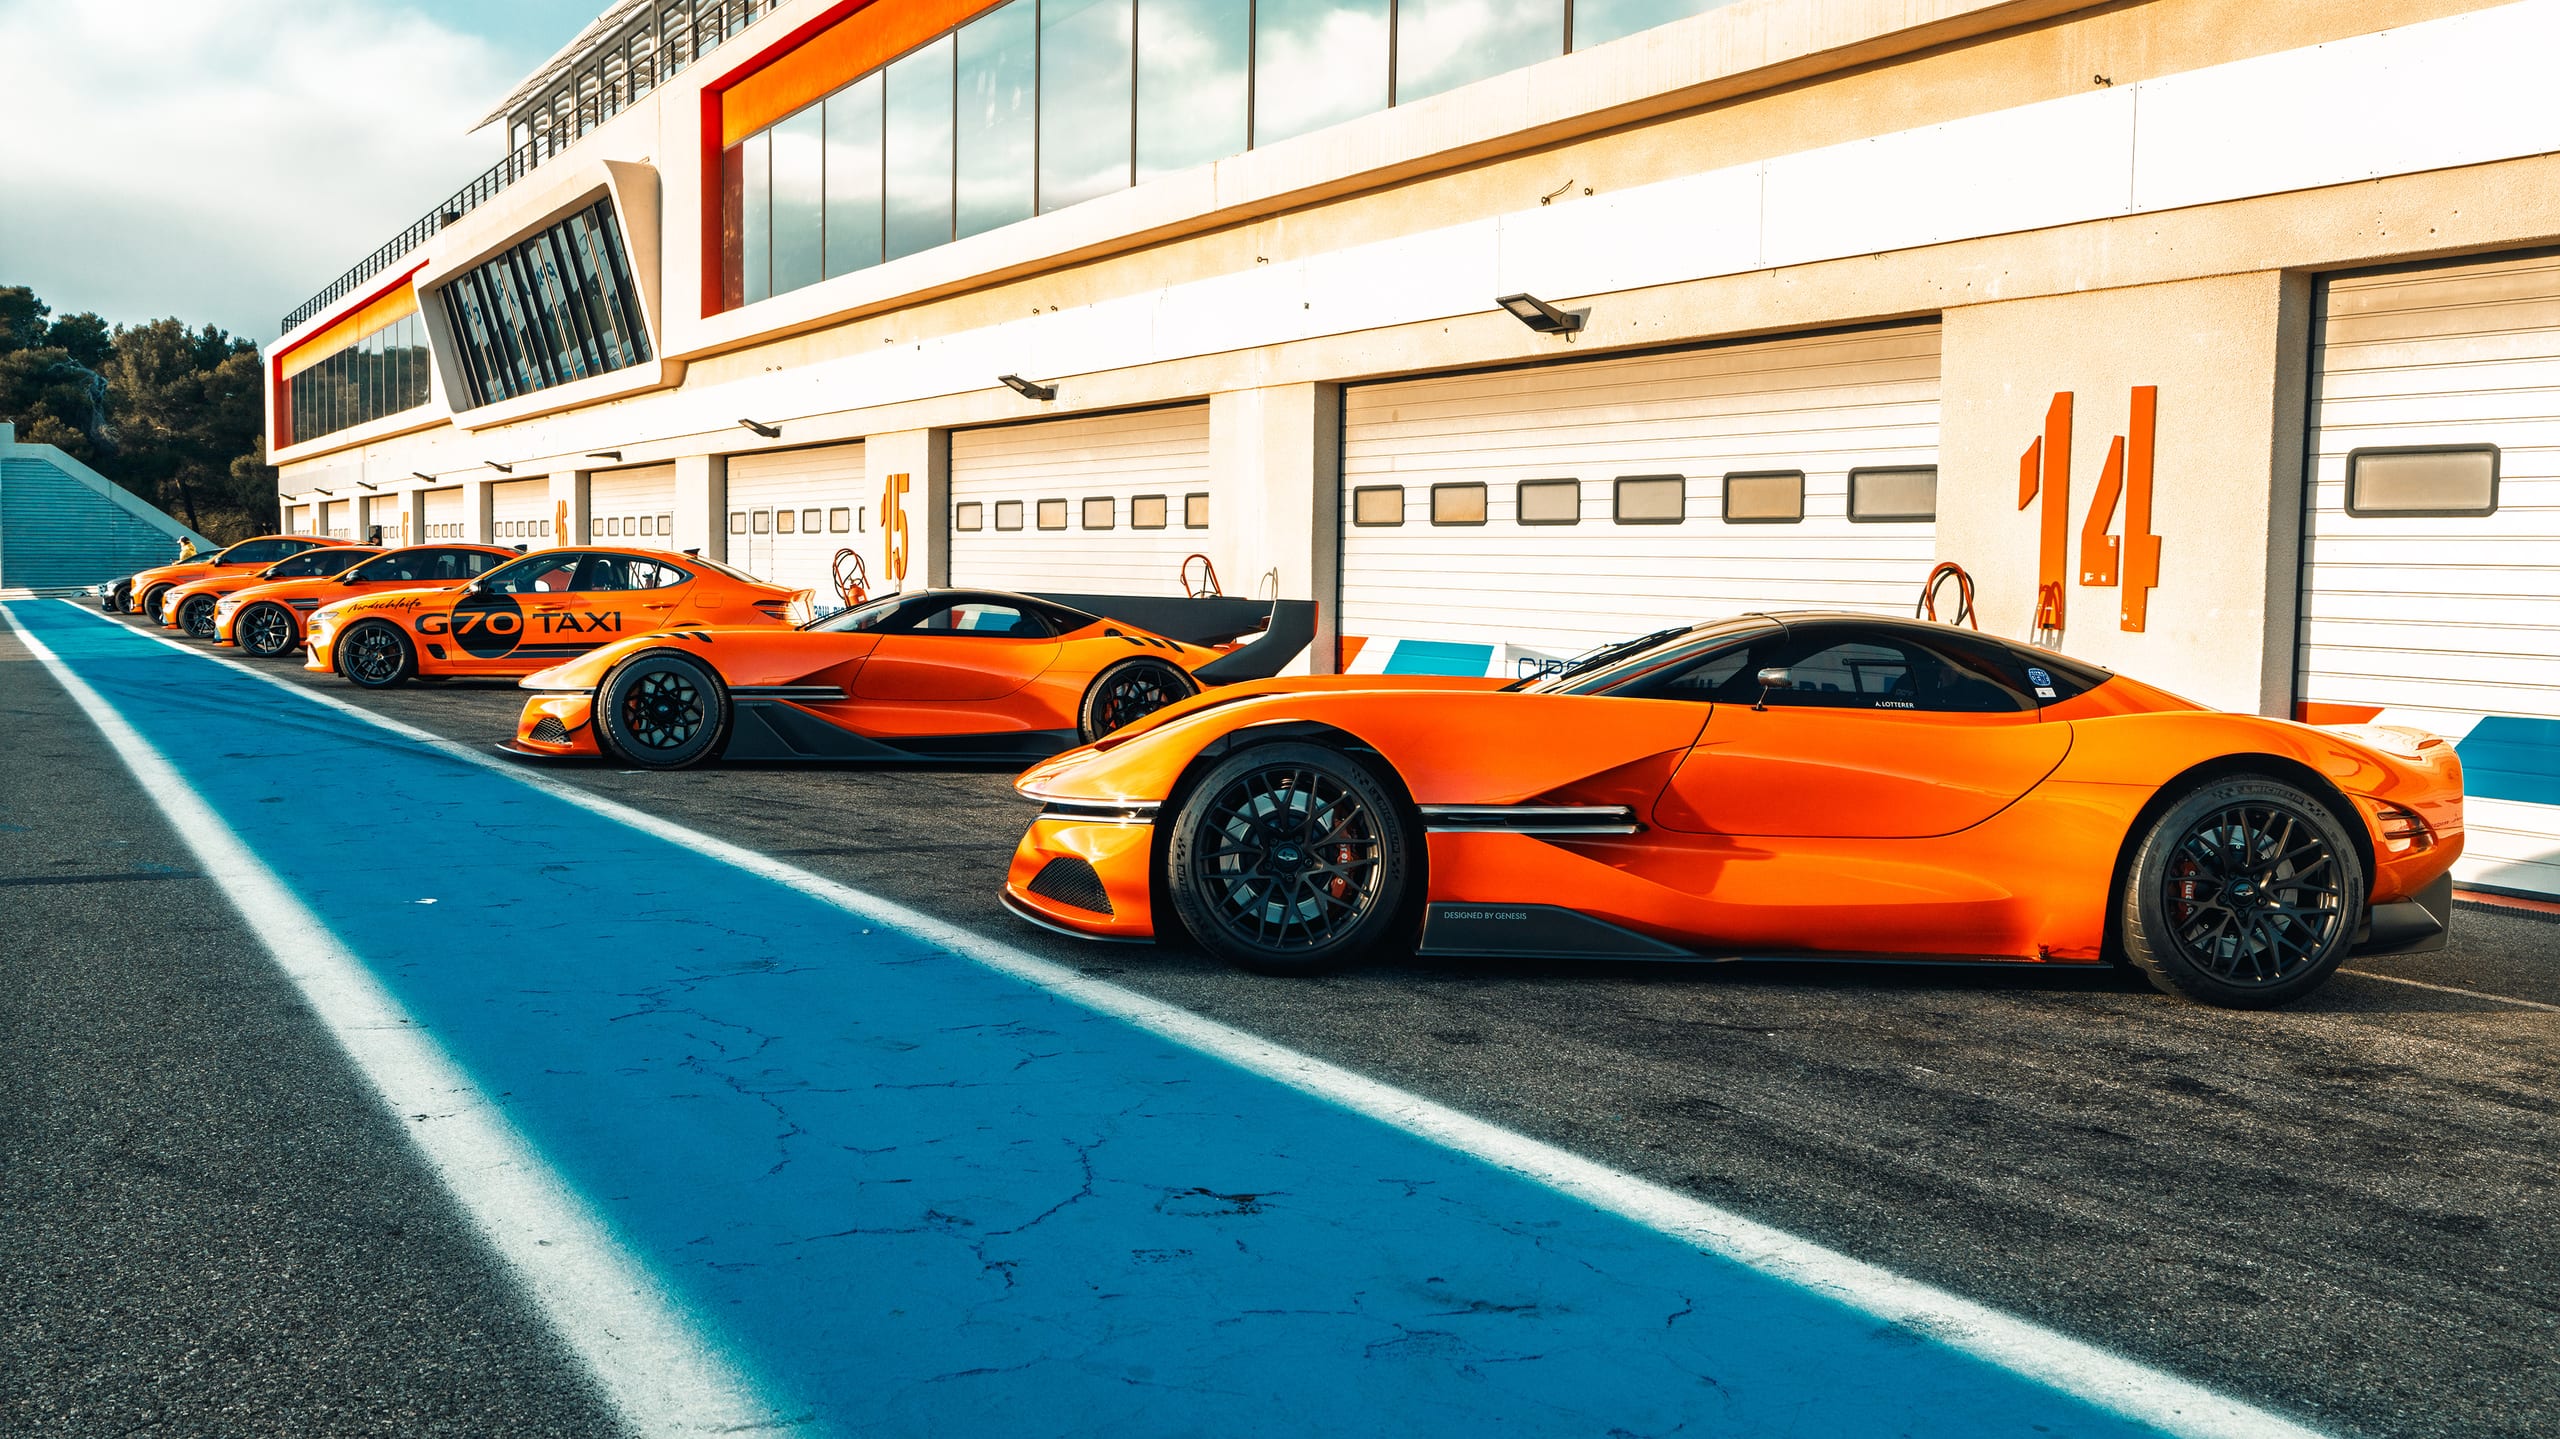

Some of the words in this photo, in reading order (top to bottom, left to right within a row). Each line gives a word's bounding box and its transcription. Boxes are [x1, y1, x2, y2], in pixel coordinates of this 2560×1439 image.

[2018, 385, 2162, 632] 14
[880, 473, 909, 580] 15
[347, 597, 421, 614] Nordschleife
[415, 612, 521, 635] G70
[532, 611, 621, 633] TAXI
[1444, 911, 1483, 919] DESIGNED
